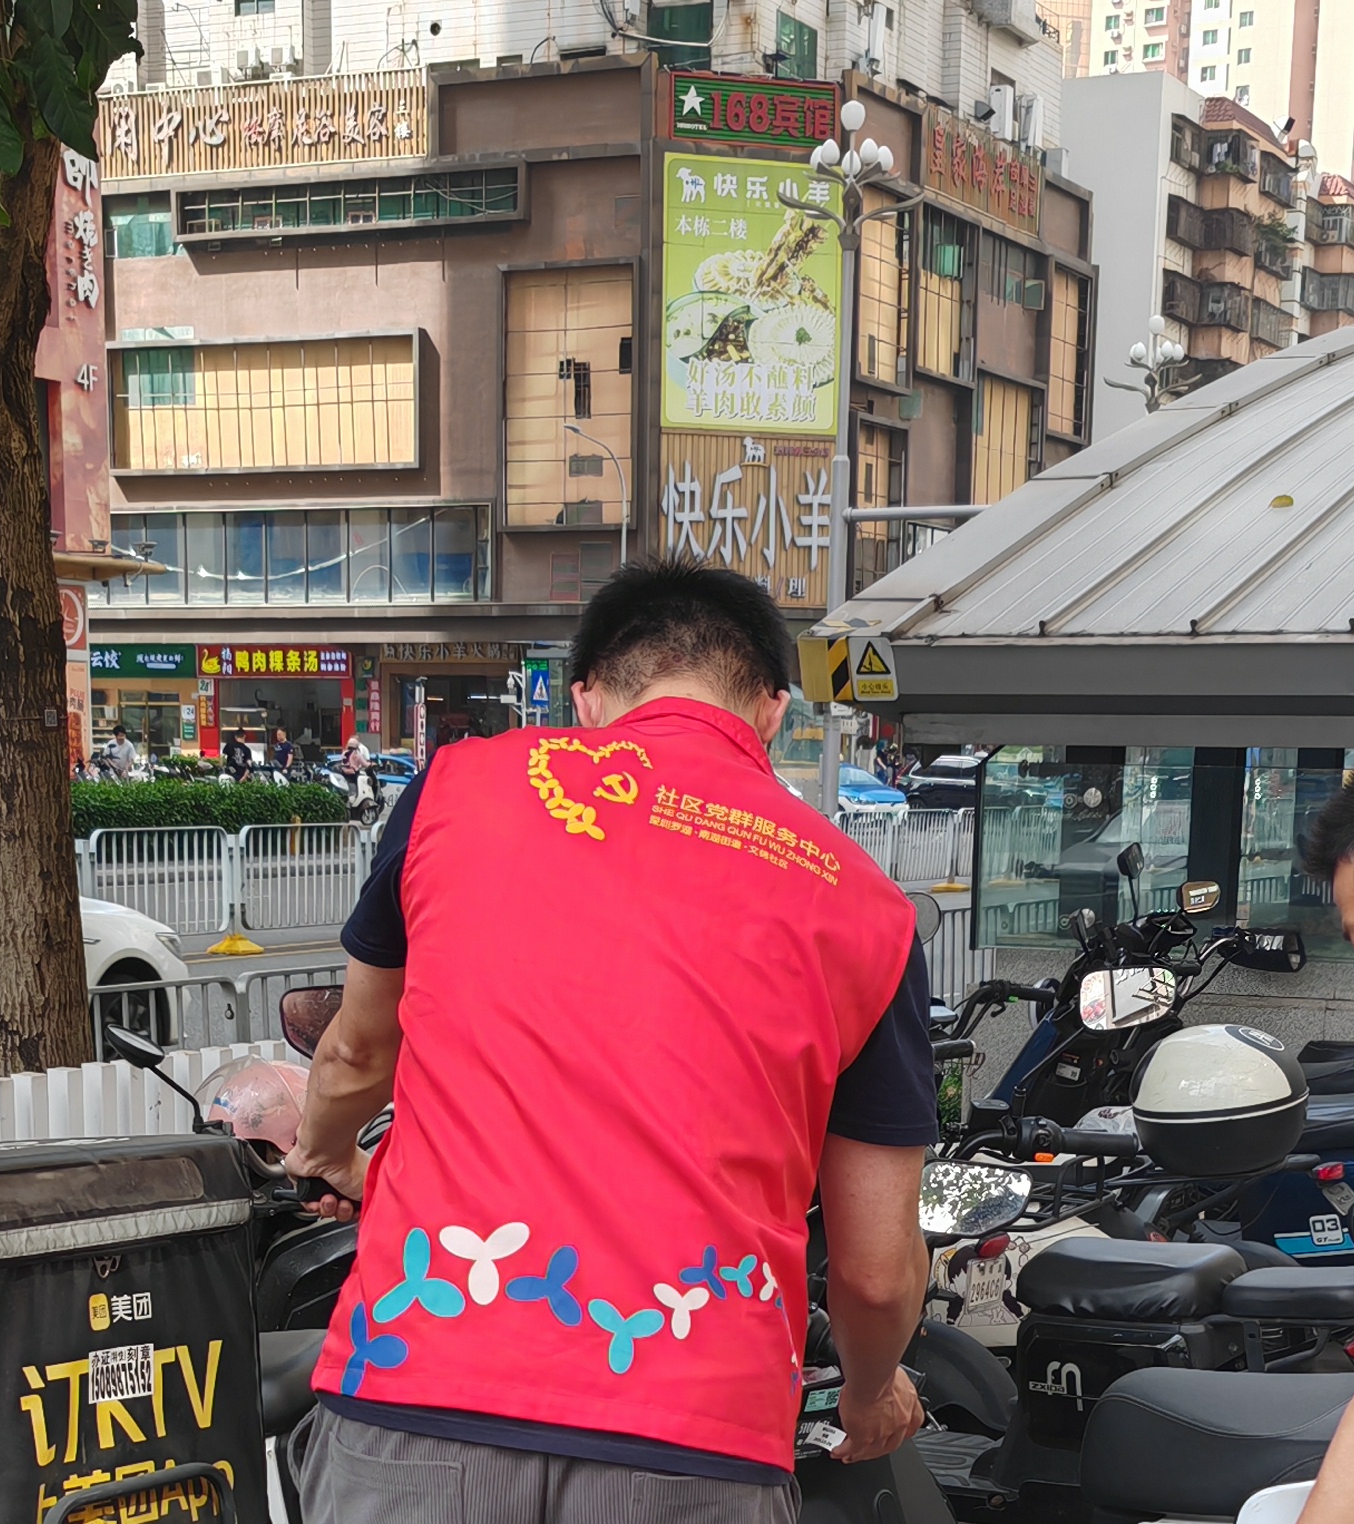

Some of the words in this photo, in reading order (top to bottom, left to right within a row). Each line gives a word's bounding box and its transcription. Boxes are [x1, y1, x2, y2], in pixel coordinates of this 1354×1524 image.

[710, 91, 832, 141] 168宾馆
[713, 172, 832, 204] 快乐小羊
[674, 215, 748, 241] 本栋二楼
[77, 364, 99, 392] 4F
[686, 359, 817, 391] 好汤不蘸料
[686, 390, 817, 423] 羊肉敢素颜
[661, 460, 832, 572] 快乐小羊
[235, 650, 319, 673] 鸭肉粿条汤
[654, 784, 841, 872] 社区党群服务中心
[651, 804, 675, 818] SHE
[676, 811, 693, 823] QU
[695, 816, 727, 833] DANG
[727, 825, 752, 840] QUN
[753, 833, 768, 846] FU
[768, 840, 786, 855] WU
[786, 848, 822, 875] ZHONG
[821, 868, 839, 886] XIN
[110, 1291, 153, 1323] 美团
[20, 1339, 224, 1467] 订KTV
